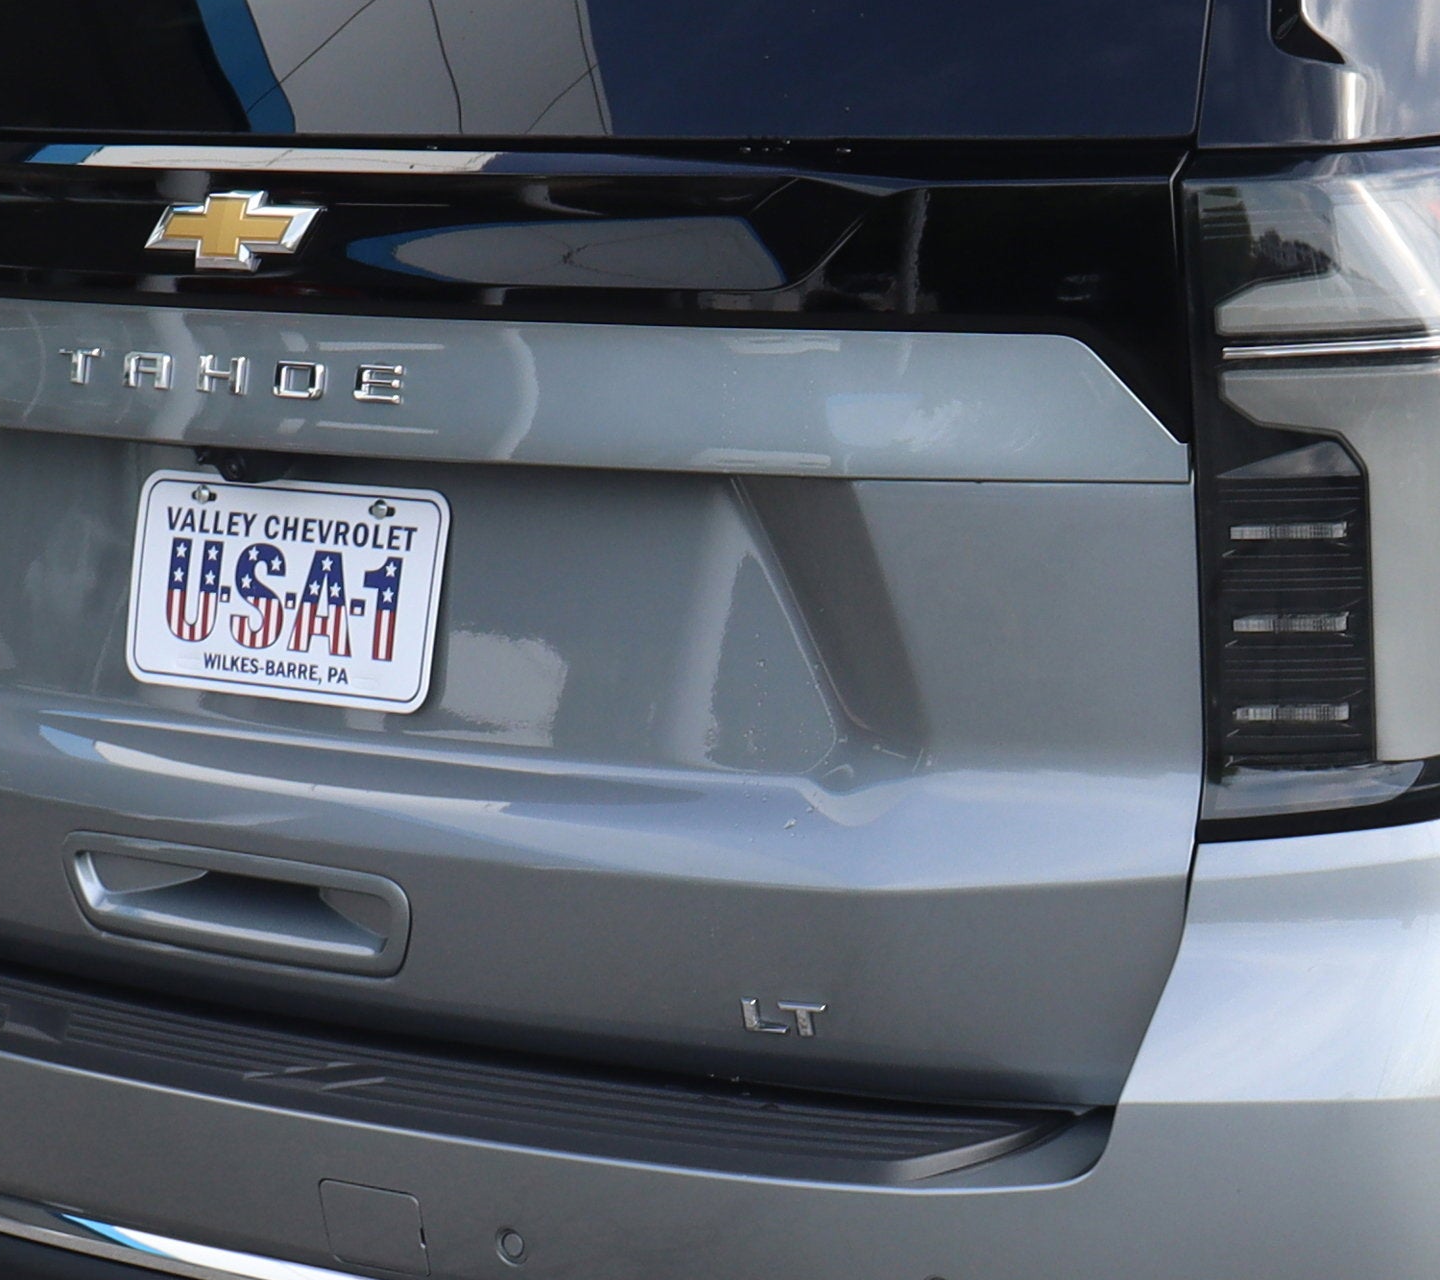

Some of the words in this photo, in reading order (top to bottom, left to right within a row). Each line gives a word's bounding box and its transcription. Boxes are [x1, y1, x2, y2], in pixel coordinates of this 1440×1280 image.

[58, 346, 406, 406] TAHOE
[167, 506, 257, 538] VALLEY
[264, 515, 418, 552] CHEVROLET
[203, 652, 322, 685] WILKES-BARRE,
[327, 666, 349, 685] PA
[740, 996, 828, 1038] LT
